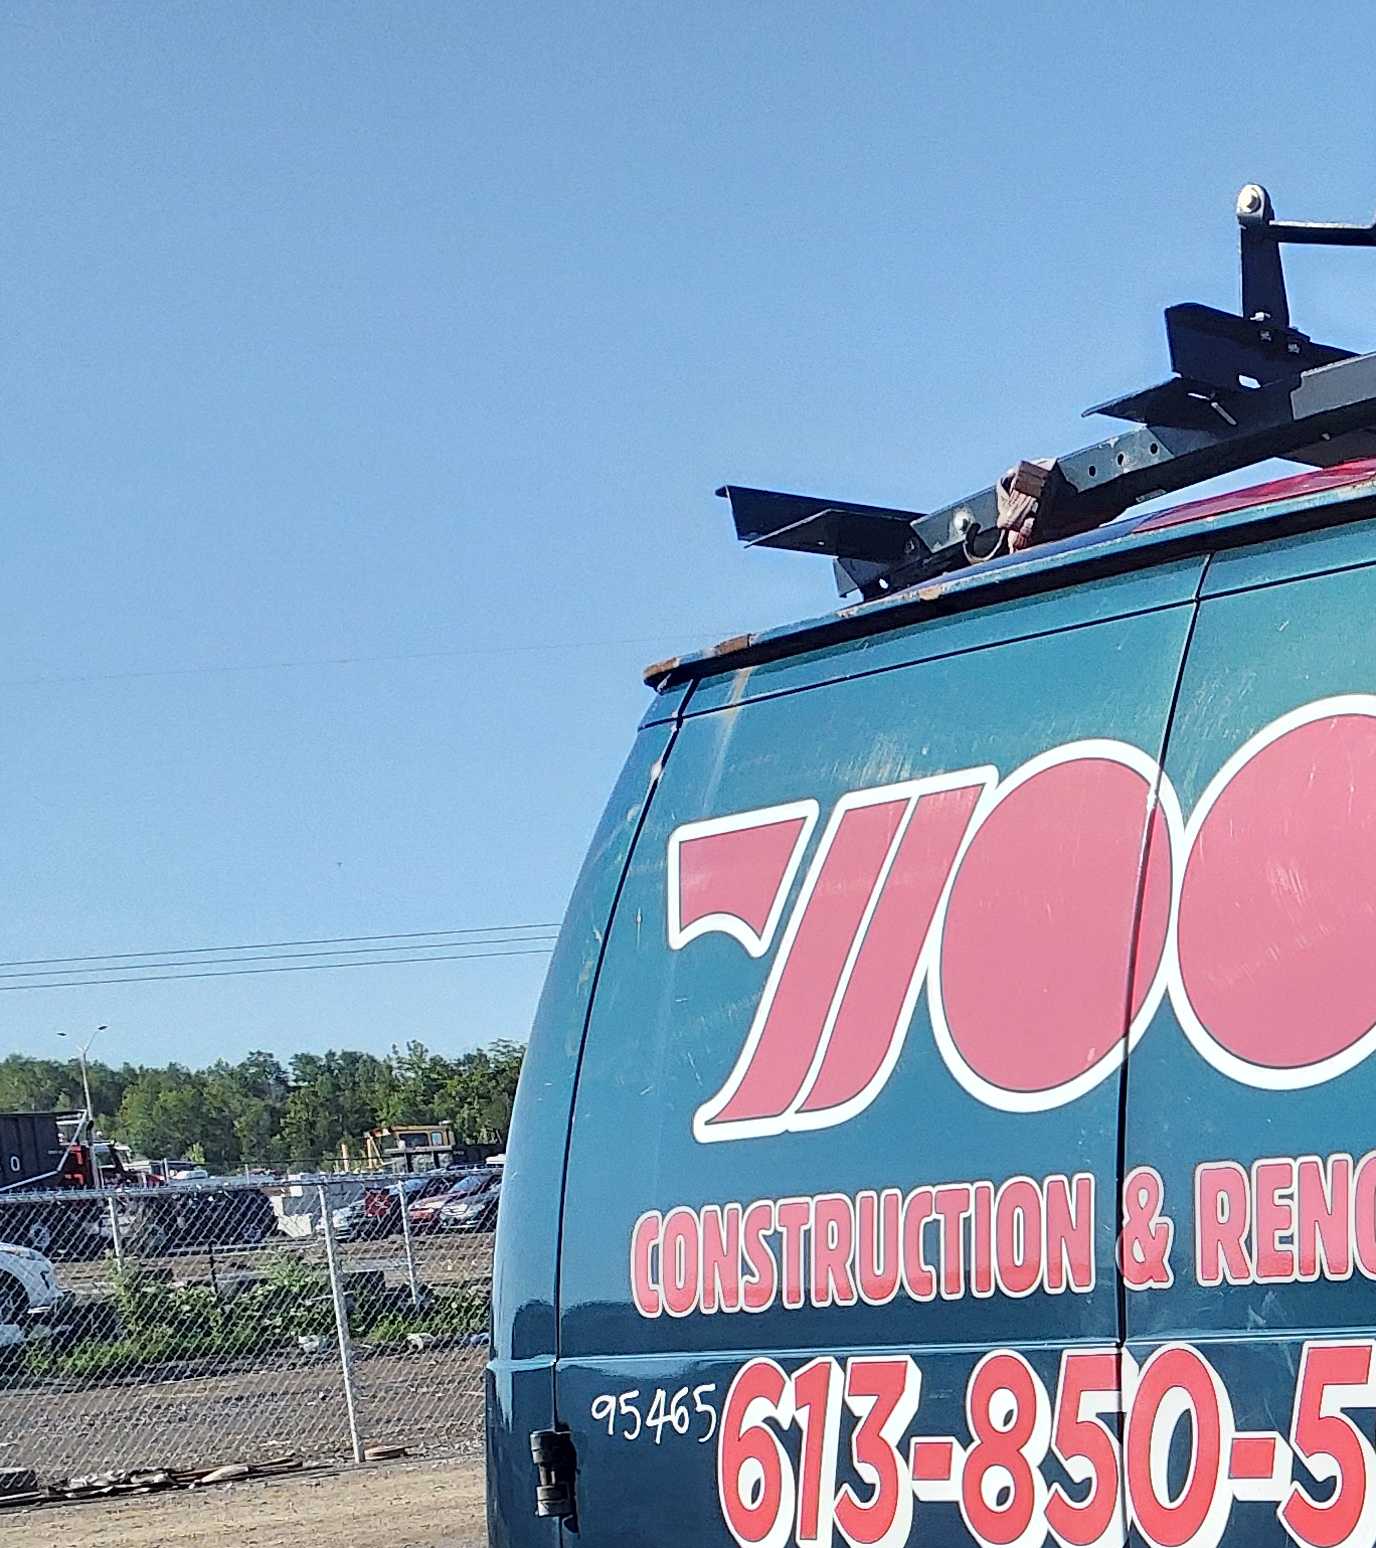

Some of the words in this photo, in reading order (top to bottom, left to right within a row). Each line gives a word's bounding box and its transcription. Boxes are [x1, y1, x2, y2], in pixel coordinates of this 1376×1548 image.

[630, 1172, 1095, 1318] CONSTRUCTION
[1116, 1165, 1174, 1290] &
[591, 1382, 717, 1446] 95465
